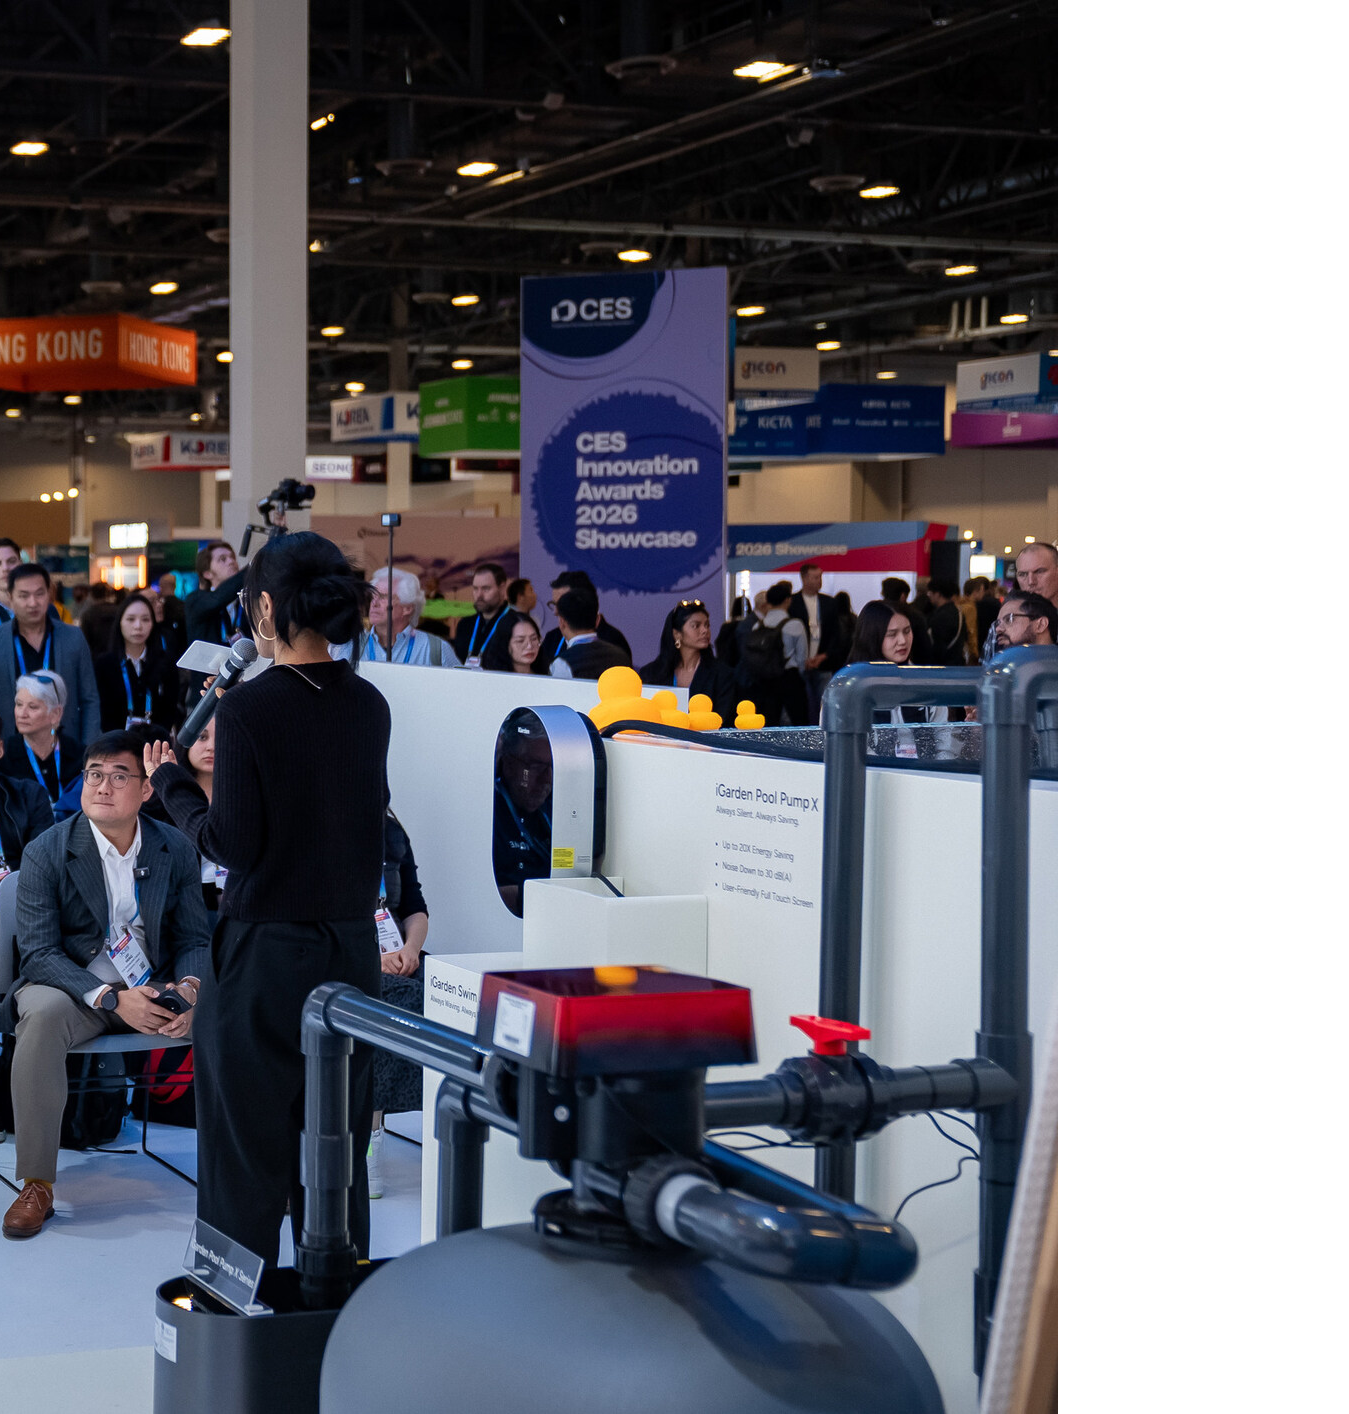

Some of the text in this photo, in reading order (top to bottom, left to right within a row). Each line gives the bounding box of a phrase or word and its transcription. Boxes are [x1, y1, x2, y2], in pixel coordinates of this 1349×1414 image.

[579, 297, 633, 321] CES
[36, 328, 102, 362] KONG
[129, 331, 190, 374] HONG KONG
[180, 440, 229, 456] KORE
[575, 431, 627, 453] CES
[576, 454, 699, 477] Innovation
[575, 479, 665, 501] Awards
[576, 504, 638, 525] 2026
[575, 528, 698, 550] Showcase
[735, 542, 848, 556] 2026 Showcase
[715, 782, 819, 812] iGarden Pool Pump X
[715, 805, 736, 817] Always
[755, 811, 777, 824] Always
[722, 840, 794, 863] Up to 20X Energy Saving
[722, 861, 738, 872] Noise
[739, 864, 756, 876] Down
[757, 868, 764, 877] to
[765, 869, 773, 879] 30
[722, 882, 814, 909] User-Friendly Full Touch Screen
[430, 974, 478, 1003] iGarden Swim
[191, 1238, 209, 1259] Garden
[208, 1249, 220, 1266] Pool
[219, 1256, 235, 1277] Pump
